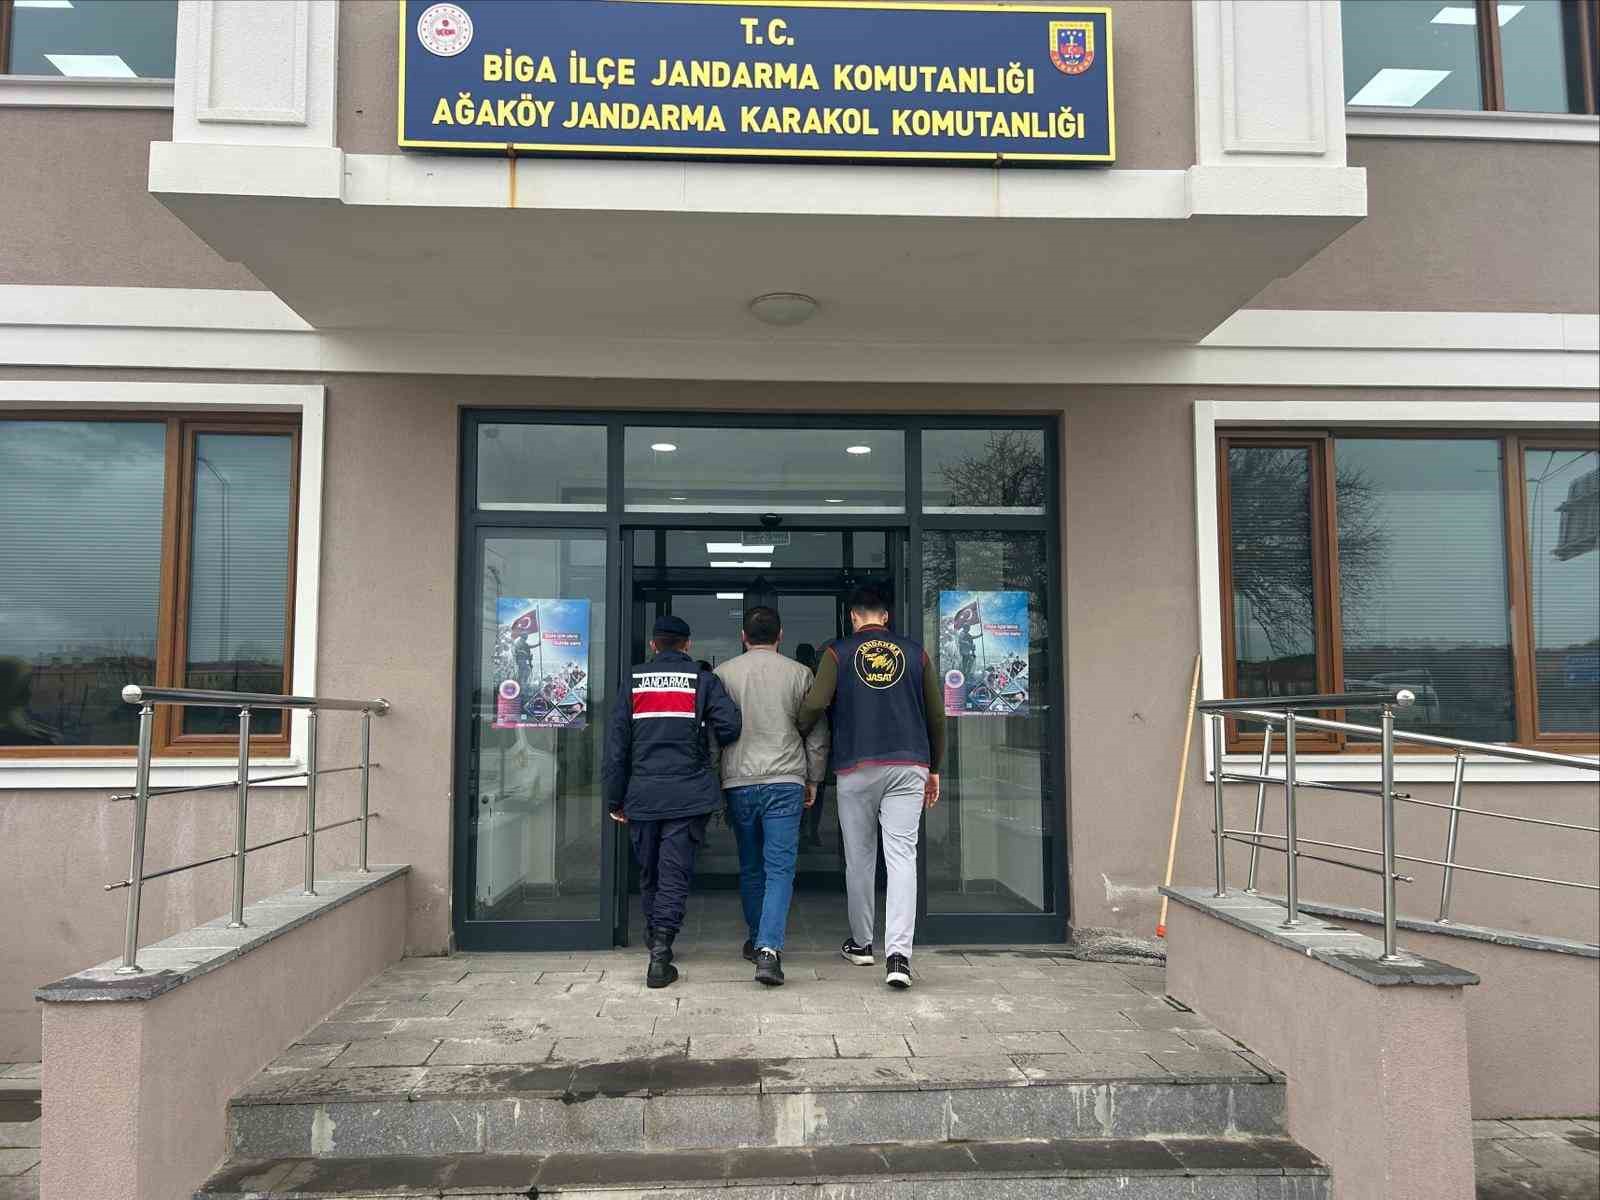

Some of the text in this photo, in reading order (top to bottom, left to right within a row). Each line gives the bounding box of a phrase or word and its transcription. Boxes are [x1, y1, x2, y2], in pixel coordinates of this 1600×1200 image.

[740, 17, 795, 46] T.C.
[482, 48, 557, 84] BİGA
[569, 50, 636, 90] İLÇE
[651, 59, 820, 91] JANDARMA
[833, 62, 1036, 95] KOMUTANLIĞI
[432, 92, 1086, 139] AĞAKÖY JANDARMA KARAKOL KOMUTANLIĞI
[857, 641, 902, 657] JANDARMA
[638, 675, 690, 689] JANDARMA
[865, 673, 894, 682] JASAT
